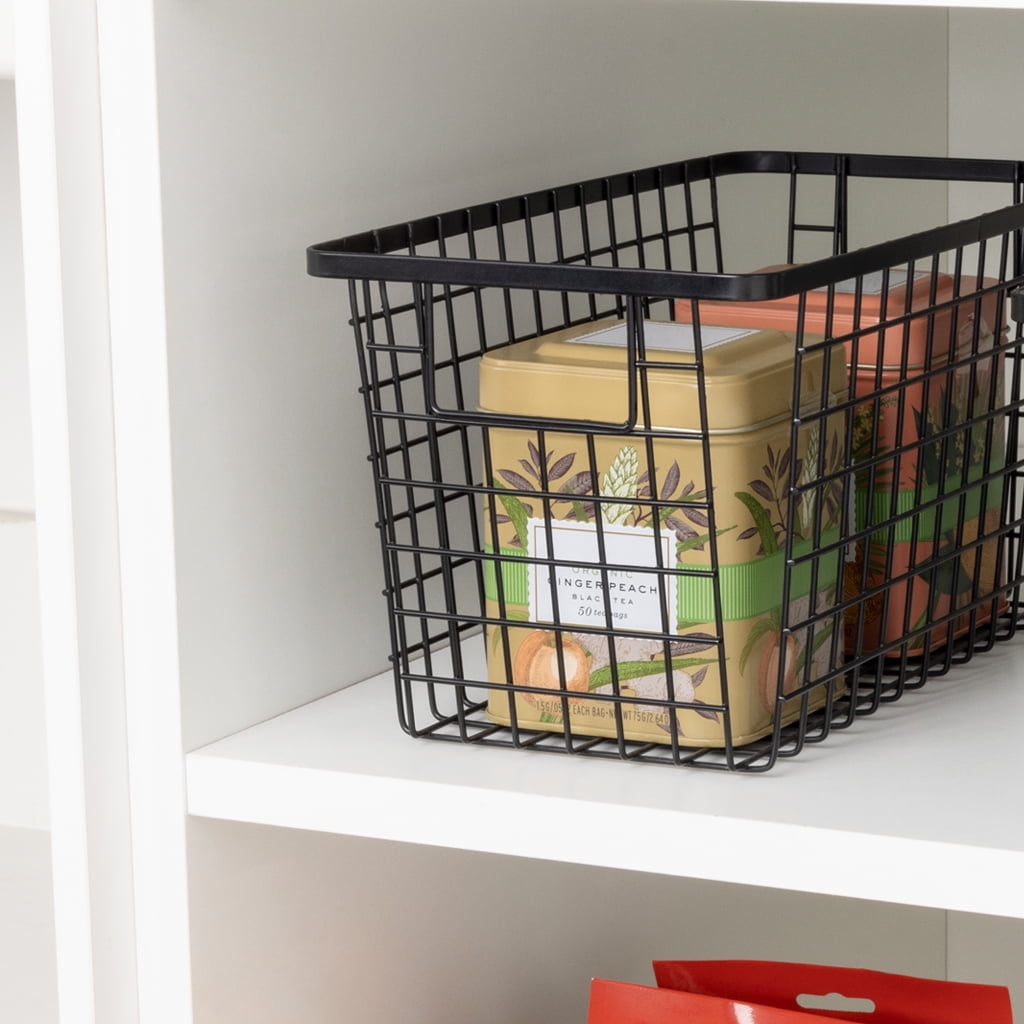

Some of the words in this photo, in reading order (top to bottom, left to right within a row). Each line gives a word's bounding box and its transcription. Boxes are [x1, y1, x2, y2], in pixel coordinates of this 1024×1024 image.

[572, 566, 633, 579] ORGNIC
[547, 577, 604, 590] INGER
[609, 582, 658, 594] PEACH
[572, 594, 604, 602] BLAC
[613, 597, 634, 605] TEA
[578, 606, 593, 617] 50
[573, 704, 590, 716] EACH
